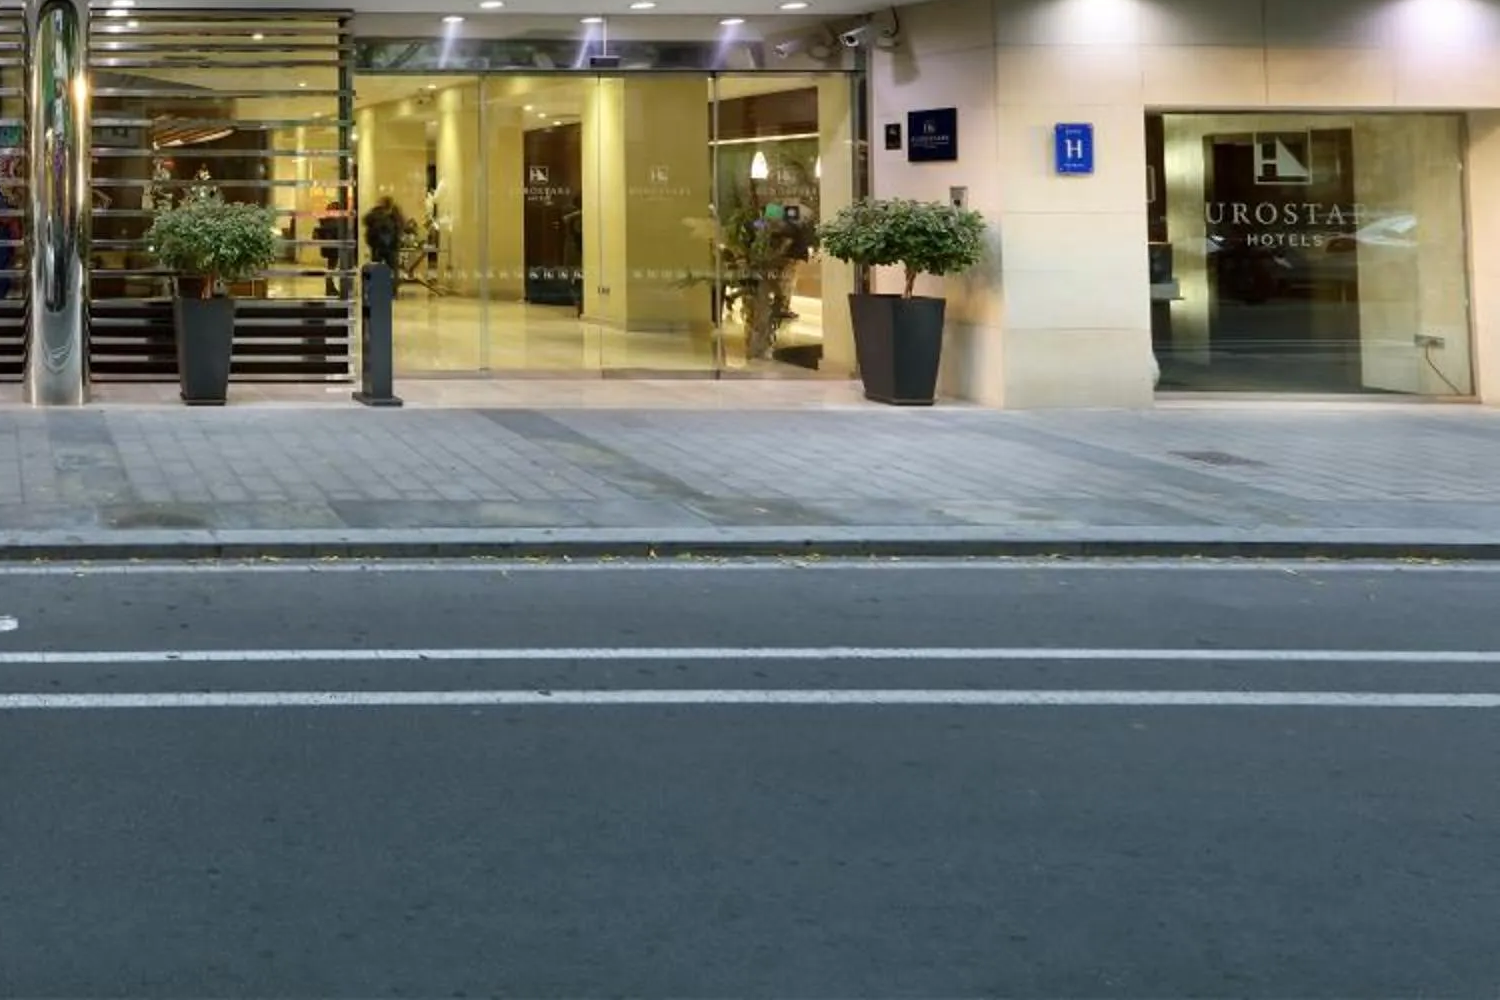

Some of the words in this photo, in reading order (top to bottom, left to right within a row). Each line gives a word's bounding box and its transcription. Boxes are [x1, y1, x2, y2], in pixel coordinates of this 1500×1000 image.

[1066, 139, 1083, 159] H
[1186, 202, 1384, 226] UROSTAR
[1246, 232, 1325, 249] HOTELS
